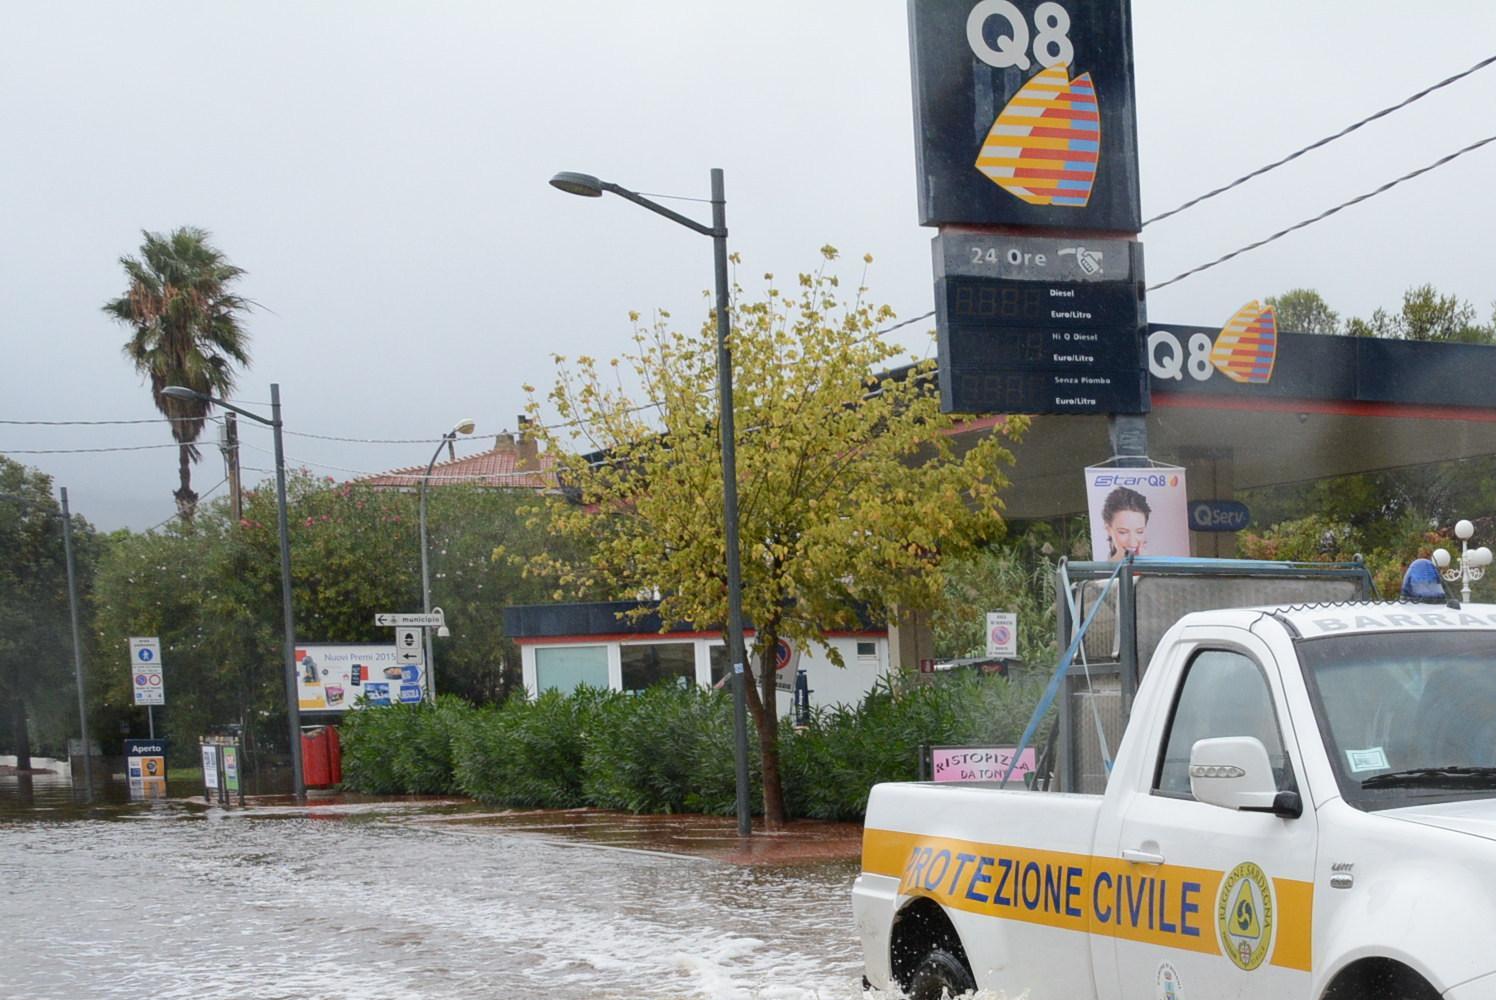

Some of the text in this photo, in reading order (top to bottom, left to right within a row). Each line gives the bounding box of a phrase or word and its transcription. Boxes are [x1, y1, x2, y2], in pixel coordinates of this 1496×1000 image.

[966, 0, 1074, 71] Q8
[971, 247, 1047, 266] 24 Ore
[1049, 289, 1075, 298] Diesel
[1050, 310, 1092, 319] Euro/Litro
[1053, 354, 1094, 362] Euro/Litro
[1147, 330, 1214, 381] Q8
[1054, 376, 1111, 385] Senza Piombo
[1055, 397, 1096, 406] Euro/Litro
[402, 616, 441, 625] municipio
[324, 652, 397, 662] Nuovi Premi 2015
[132, 745, 162, 755] Aperto
[936, 752, 1030, 773] RISTOPIZA
[961, 770, 976, 779] DA
[907, 847, 1201, 937] PROTEZIONE CIVILE
